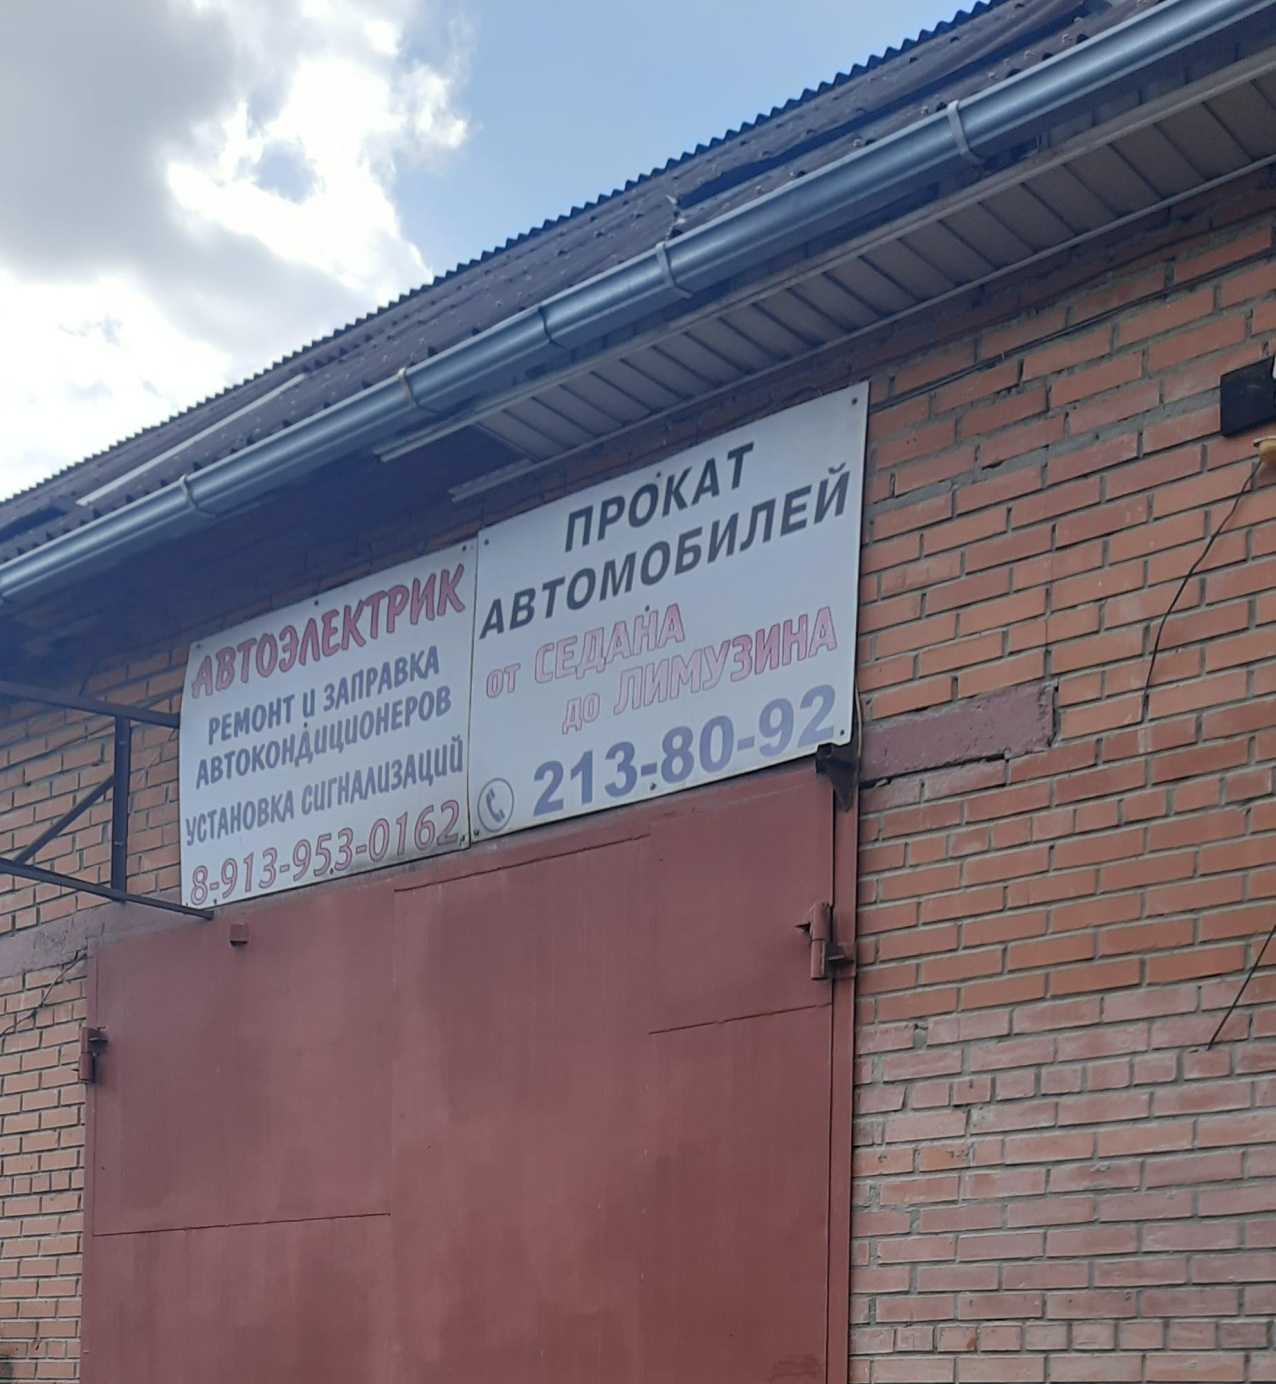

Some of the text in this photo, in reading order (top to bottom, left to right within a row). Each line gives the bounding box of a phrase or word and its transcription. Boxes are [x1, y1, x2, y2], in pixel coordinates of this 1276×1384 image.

[479, 462, 850, 640] АВТОМОБИЛЕЙ
[565, 441, 755, 552] ПРОКАТ
[191, 563, 466, 699] АВТОЭЛЕКТРИК
[534, 602, 685, 684] СЕДАНА
[612, 606, 838, 715] ЛИМУЗИНА
[196, 685, 452, 790] АВТОКОНДИЦИОНЕРОВ
[208, 694, 296, 746] РЕМОНТ
[323, 645, 440, 713] ЗАПРАВКА
[532, 683, 836, 817] 213-80-92
[185, 734, 464, 846] УСТАНОВКА СИГНАЛИЗАЦИЙ
[190, 799, 461, 906] 8-913-953-0162
